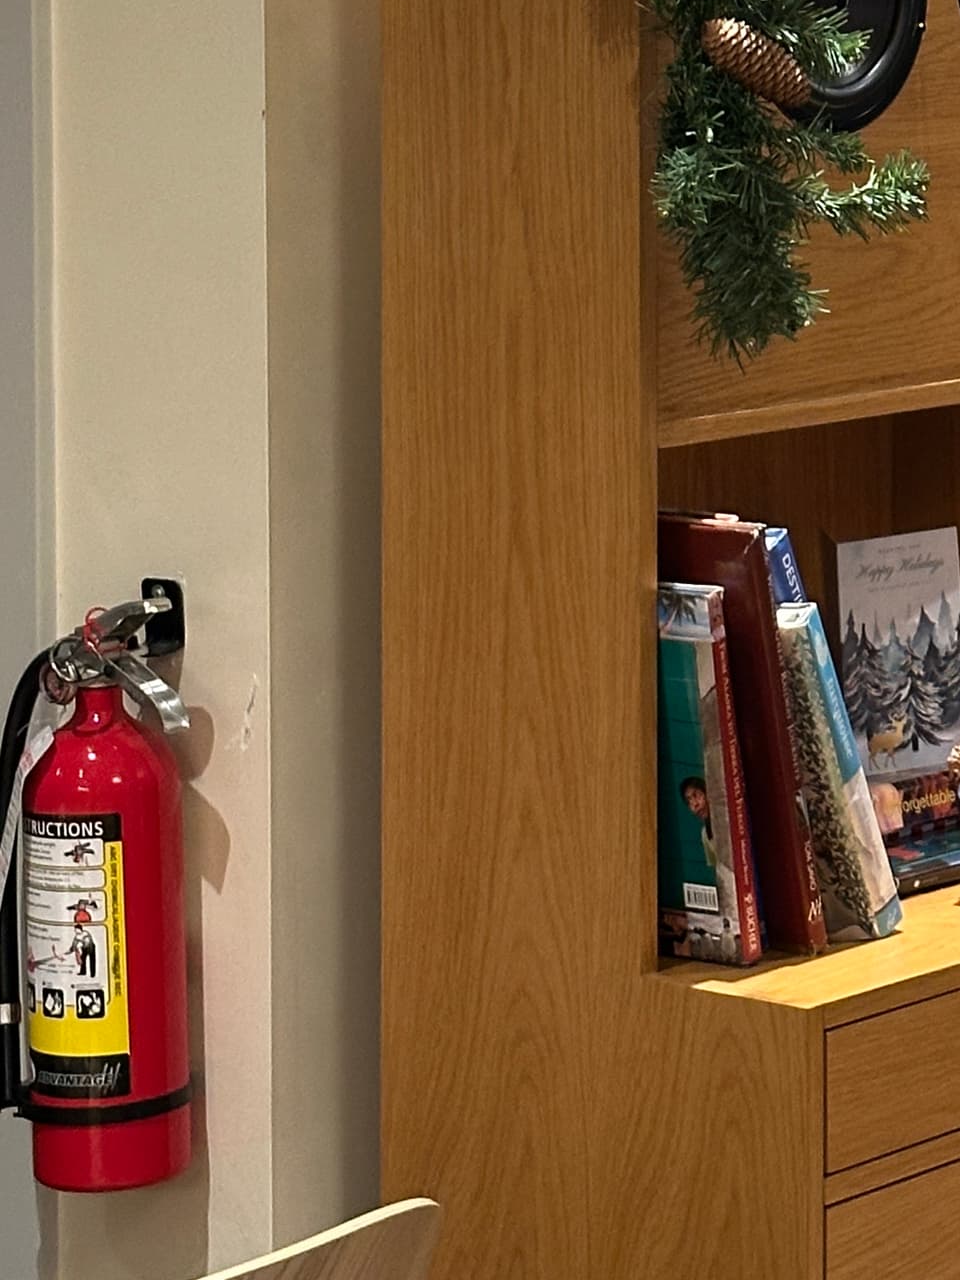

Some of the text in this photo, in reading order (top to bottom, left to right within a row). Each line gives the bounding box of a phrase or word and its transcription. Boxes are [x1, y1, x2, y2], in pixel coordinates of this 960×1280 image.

[782, 553, 803, 603] DESTI
[856, 552, 944, 583] Happy Holidays
